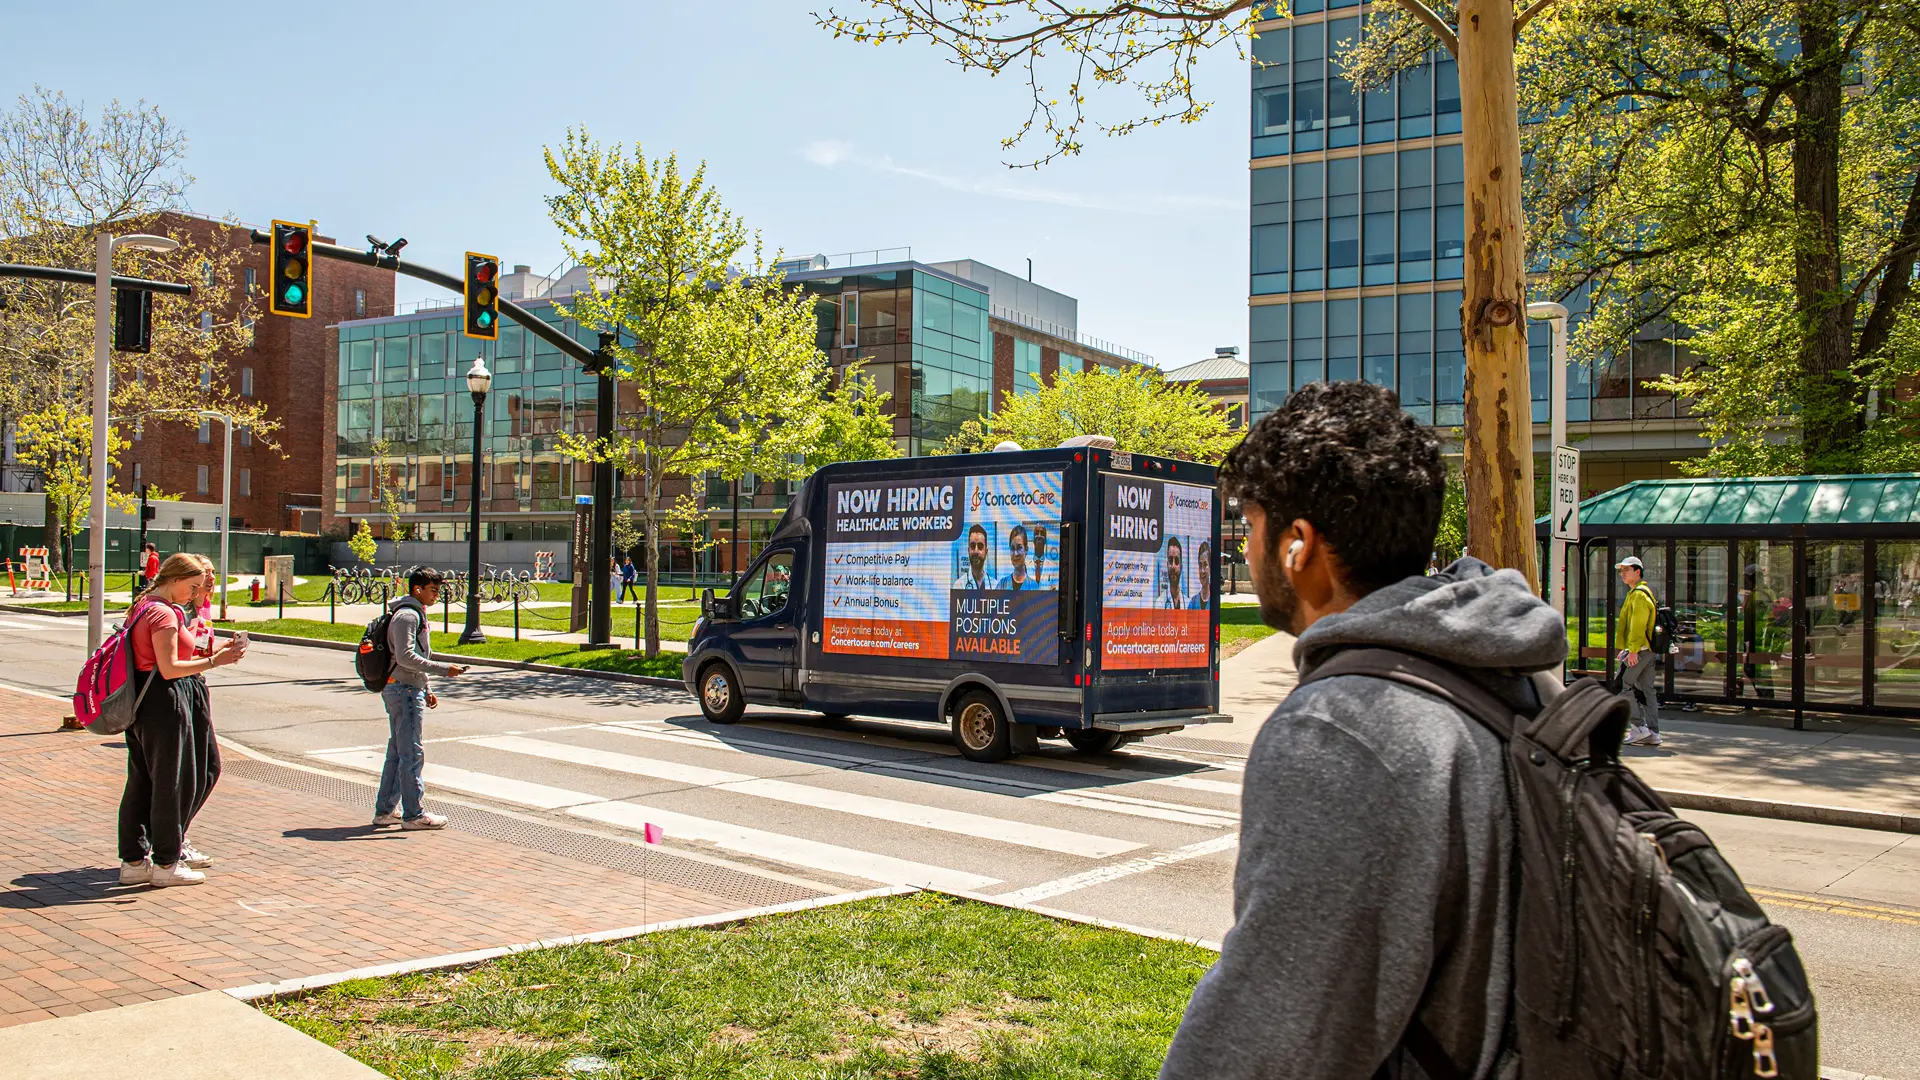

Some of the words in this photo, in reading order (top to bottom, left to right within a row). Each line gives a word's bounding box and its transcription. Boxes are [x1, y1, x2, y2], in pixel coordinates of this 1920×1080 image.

[1559, 454, 1576, 470] STOP
[1558, 474, 1568, 483] HERE
[1570, 476, 1576, 484] ON
[838, 489, 881, 514] NOW
[887, 486, 953, 512] HIRING
[985, 489, 1054, 506] ConcertoCare
[1118, 485, 1151, 510] NOW
[1176, 496, 1208, 510] ConcertoCare
[1560, 488, 1573, 504] RED
[837, 518, 898, 532] HEALTHCARE
[902, 516, 952, 530] WORKERS
[1110, 515, 1158, 540] HIRING
[846, 554, 893, 566] Competitive
[895, 554, 910, 566] Pay
[1114, 562, 1139, 571] Competitive
[846, 575, 880, 586] Work-life
[882, 576, 913, 586] balance
[845, 596, 872, 607] Annual
[874, 597, 898, 607] Bonus
[956, 598, 1010, 614] MULTIPLE
[832, 624, 850, 636] Apply
[852, 625, 872, 635] online
[874, 626, 892, 638] today
[895, 628, 902, 636] at
[956, 618, 1016, 634] POSITIONS
[1107, 622, 1130, 639] Apply
[1132, 622, 1156, 636] online
[1158, 622, 1179, 639] today
[1181, 624, 1188, 636] at
[831, 636, 919, 650] Concertocare.com/careers
[956, 637, 1020, 654] AVAILABLE
[1106, 640, 1206, 654] Concertocare.com/careers
